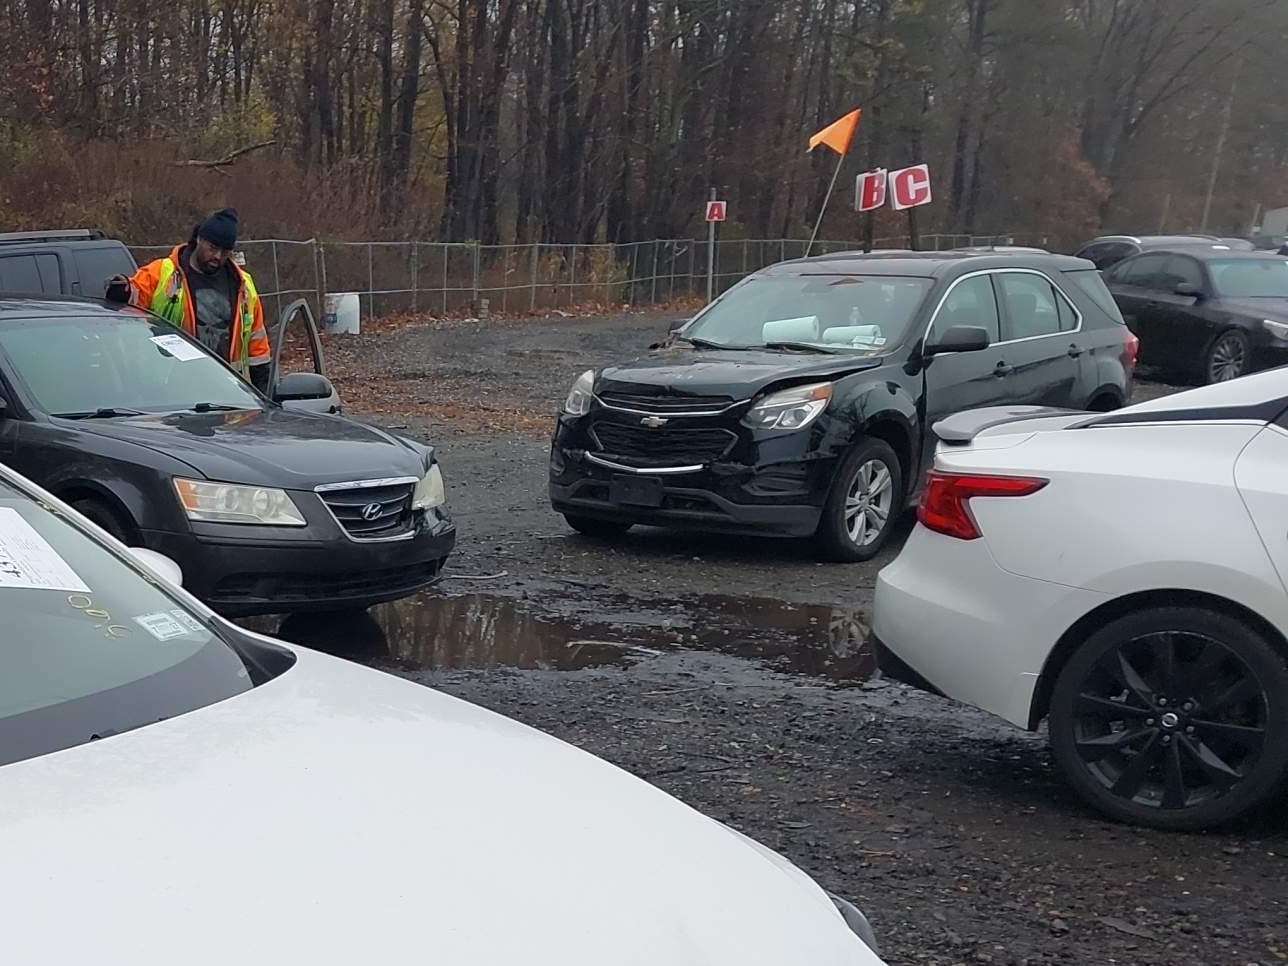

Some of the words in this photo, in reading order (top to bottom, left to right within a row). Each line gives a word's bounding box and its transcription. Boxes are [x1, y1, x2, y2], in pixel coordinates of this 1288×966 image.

[862, 173, 885, 209] B
[895, 168, 929, 206] C
[708, 202, 724, 220] A
